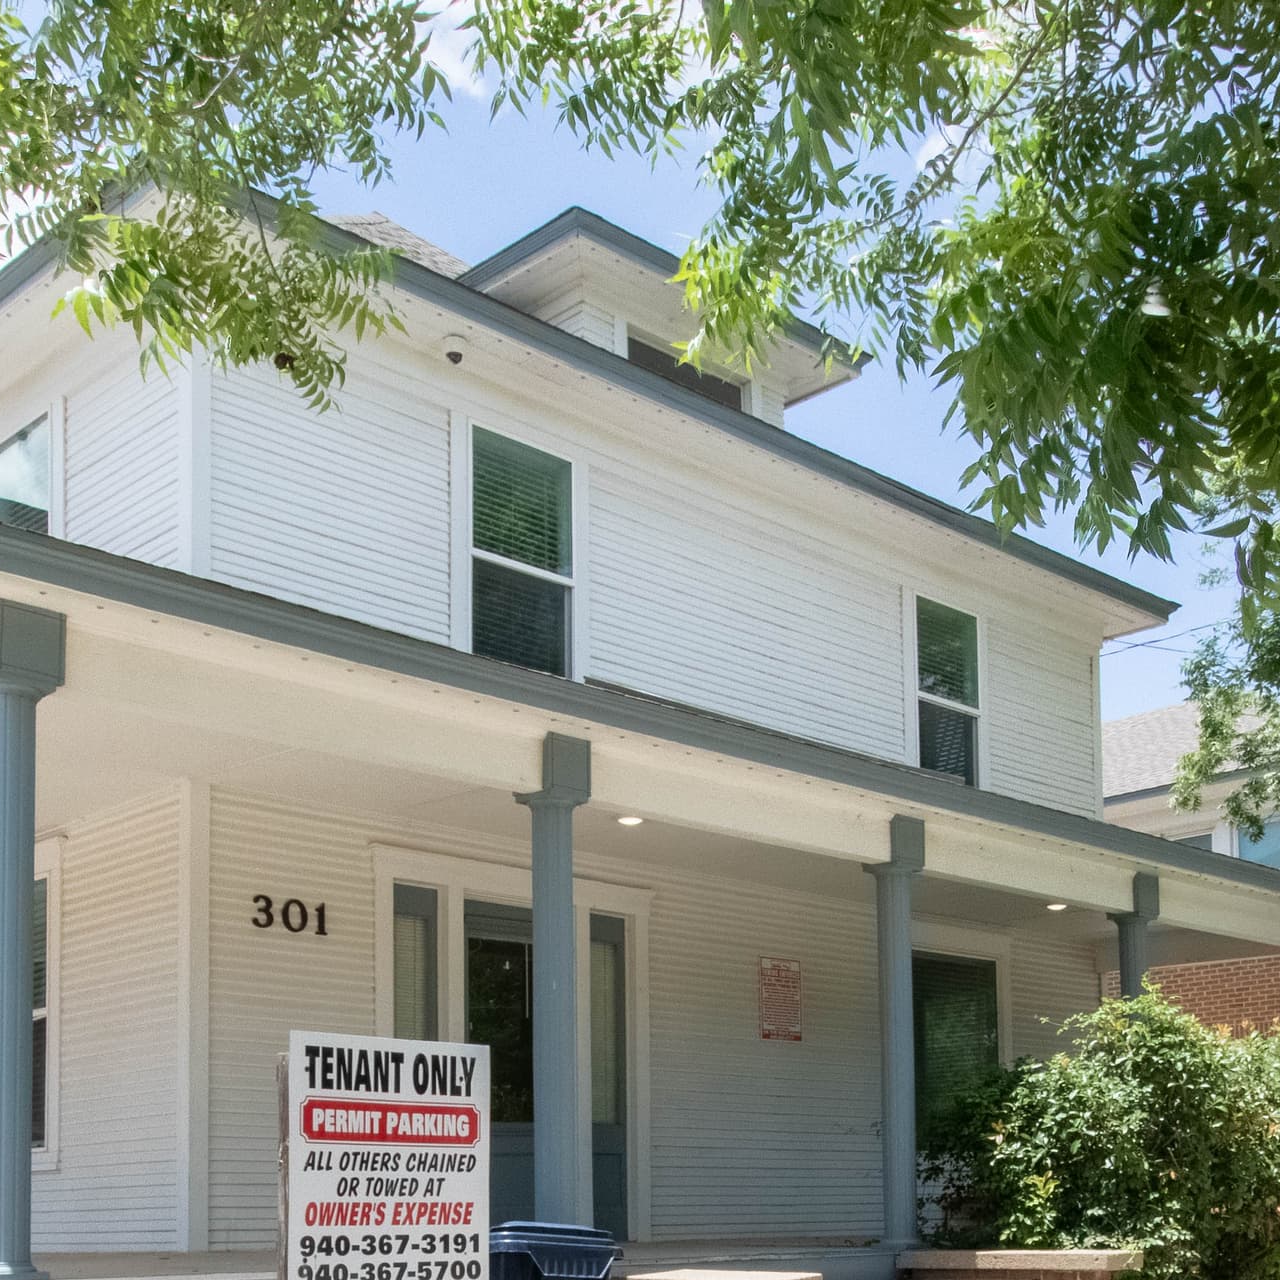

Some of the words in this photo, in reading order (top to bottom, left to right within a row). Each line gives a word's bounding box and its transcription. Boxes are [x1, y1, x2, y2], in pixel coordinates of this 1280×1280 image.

[251, 894, 329, 936] 301
[305, 1045, 404, 1094] TENANT
[413, 1053, 476, 1097] ONLY
[312, 1108, 383, 1135] PERMIT
[386, 1112, 470, 1137] PARKING
[303, 1151, 333, 1172] ALL
[339, 1152, 401, 1172] OTHERS
[405, 1152, 476, 1173] CHAINED
[336, 1177, 358, 1197] OR
[365, 1177, 419, 1197] TOWED
[423, 1177, 446, 1197] AT
[305, 1202, 386, 1226] OWNER'S
[391, 1202, 474, 1226] EXPENSE
[299, 1233, 480, 1257] 940-367-3191
